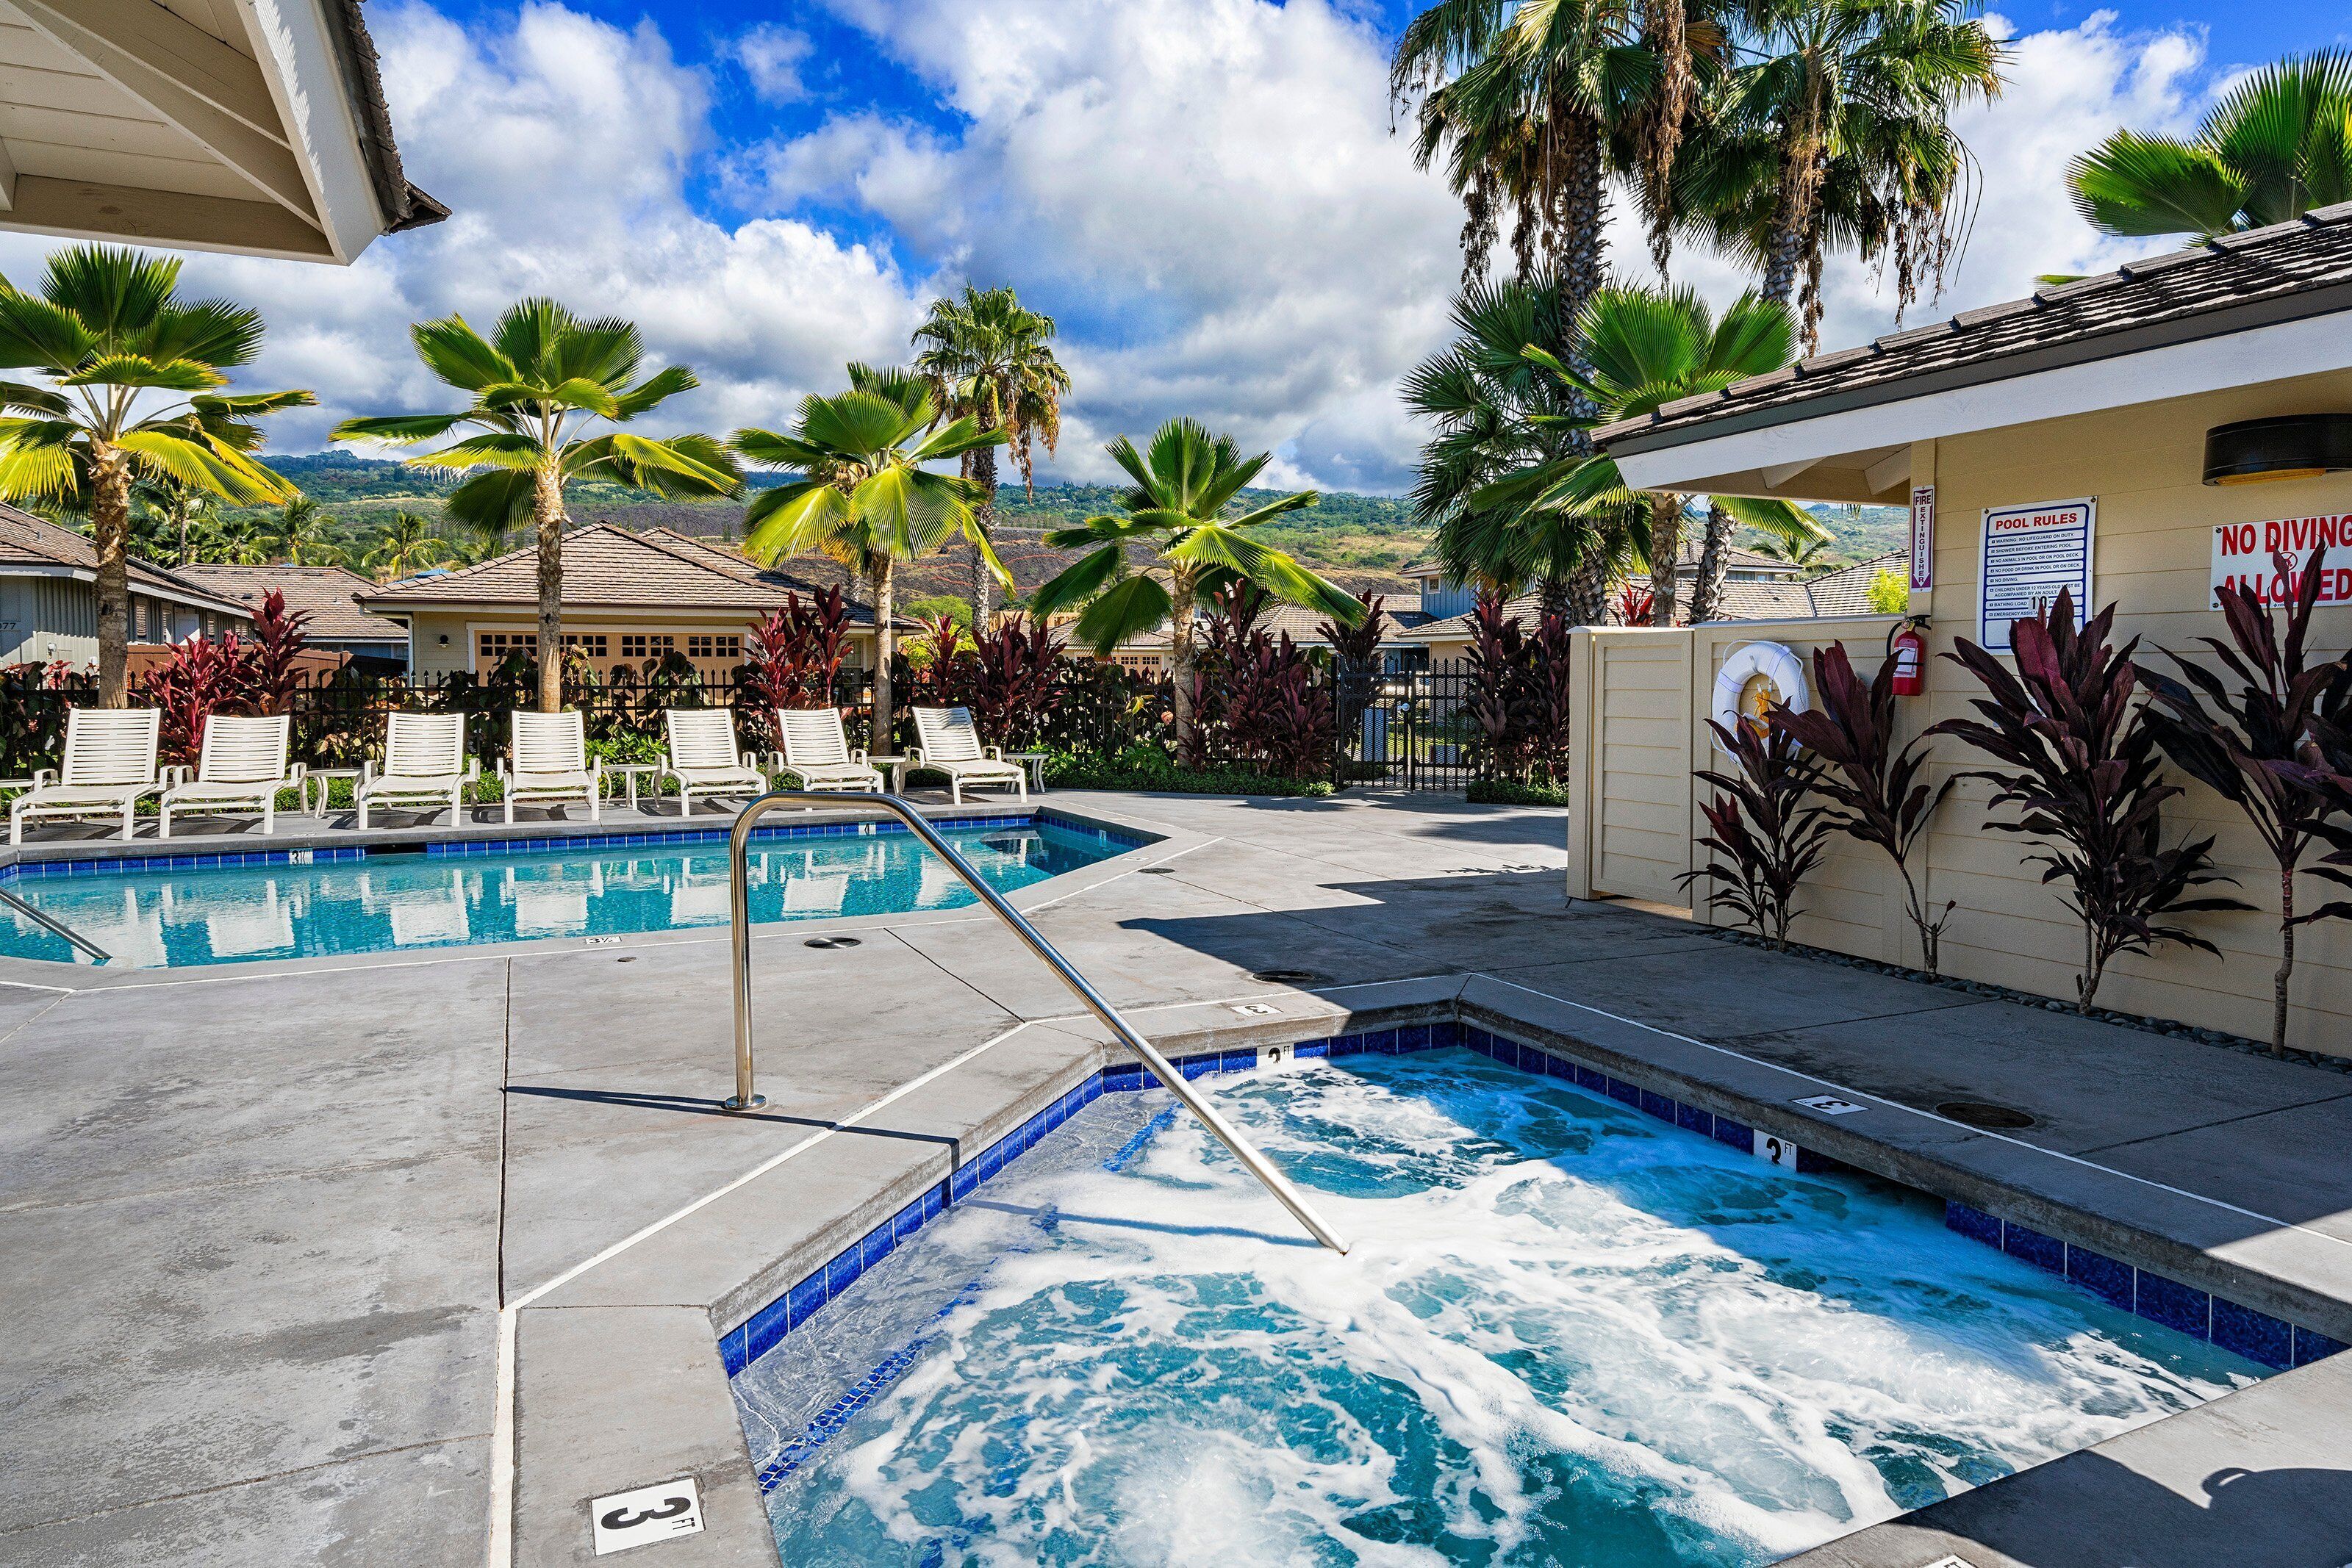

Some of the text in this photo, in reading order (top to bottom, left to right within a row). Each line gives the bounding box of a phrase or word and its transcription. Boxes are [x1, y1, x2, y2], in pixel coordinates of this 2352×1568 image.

[1915, 495, 1931, 506] FIRE
[1996, 513, 2077, 530] POOL RULES
[2222, 515, 2352, 555] NO DIVING
[2032, 596, 2047, 609] 10
[1283, 1046, 1290, 1054] FT
[1812, 1101, 1850, 1109] 3
[1785, 1143, 1793, 1155] FT
[601, 1497, 695, 1530] 3 FT
